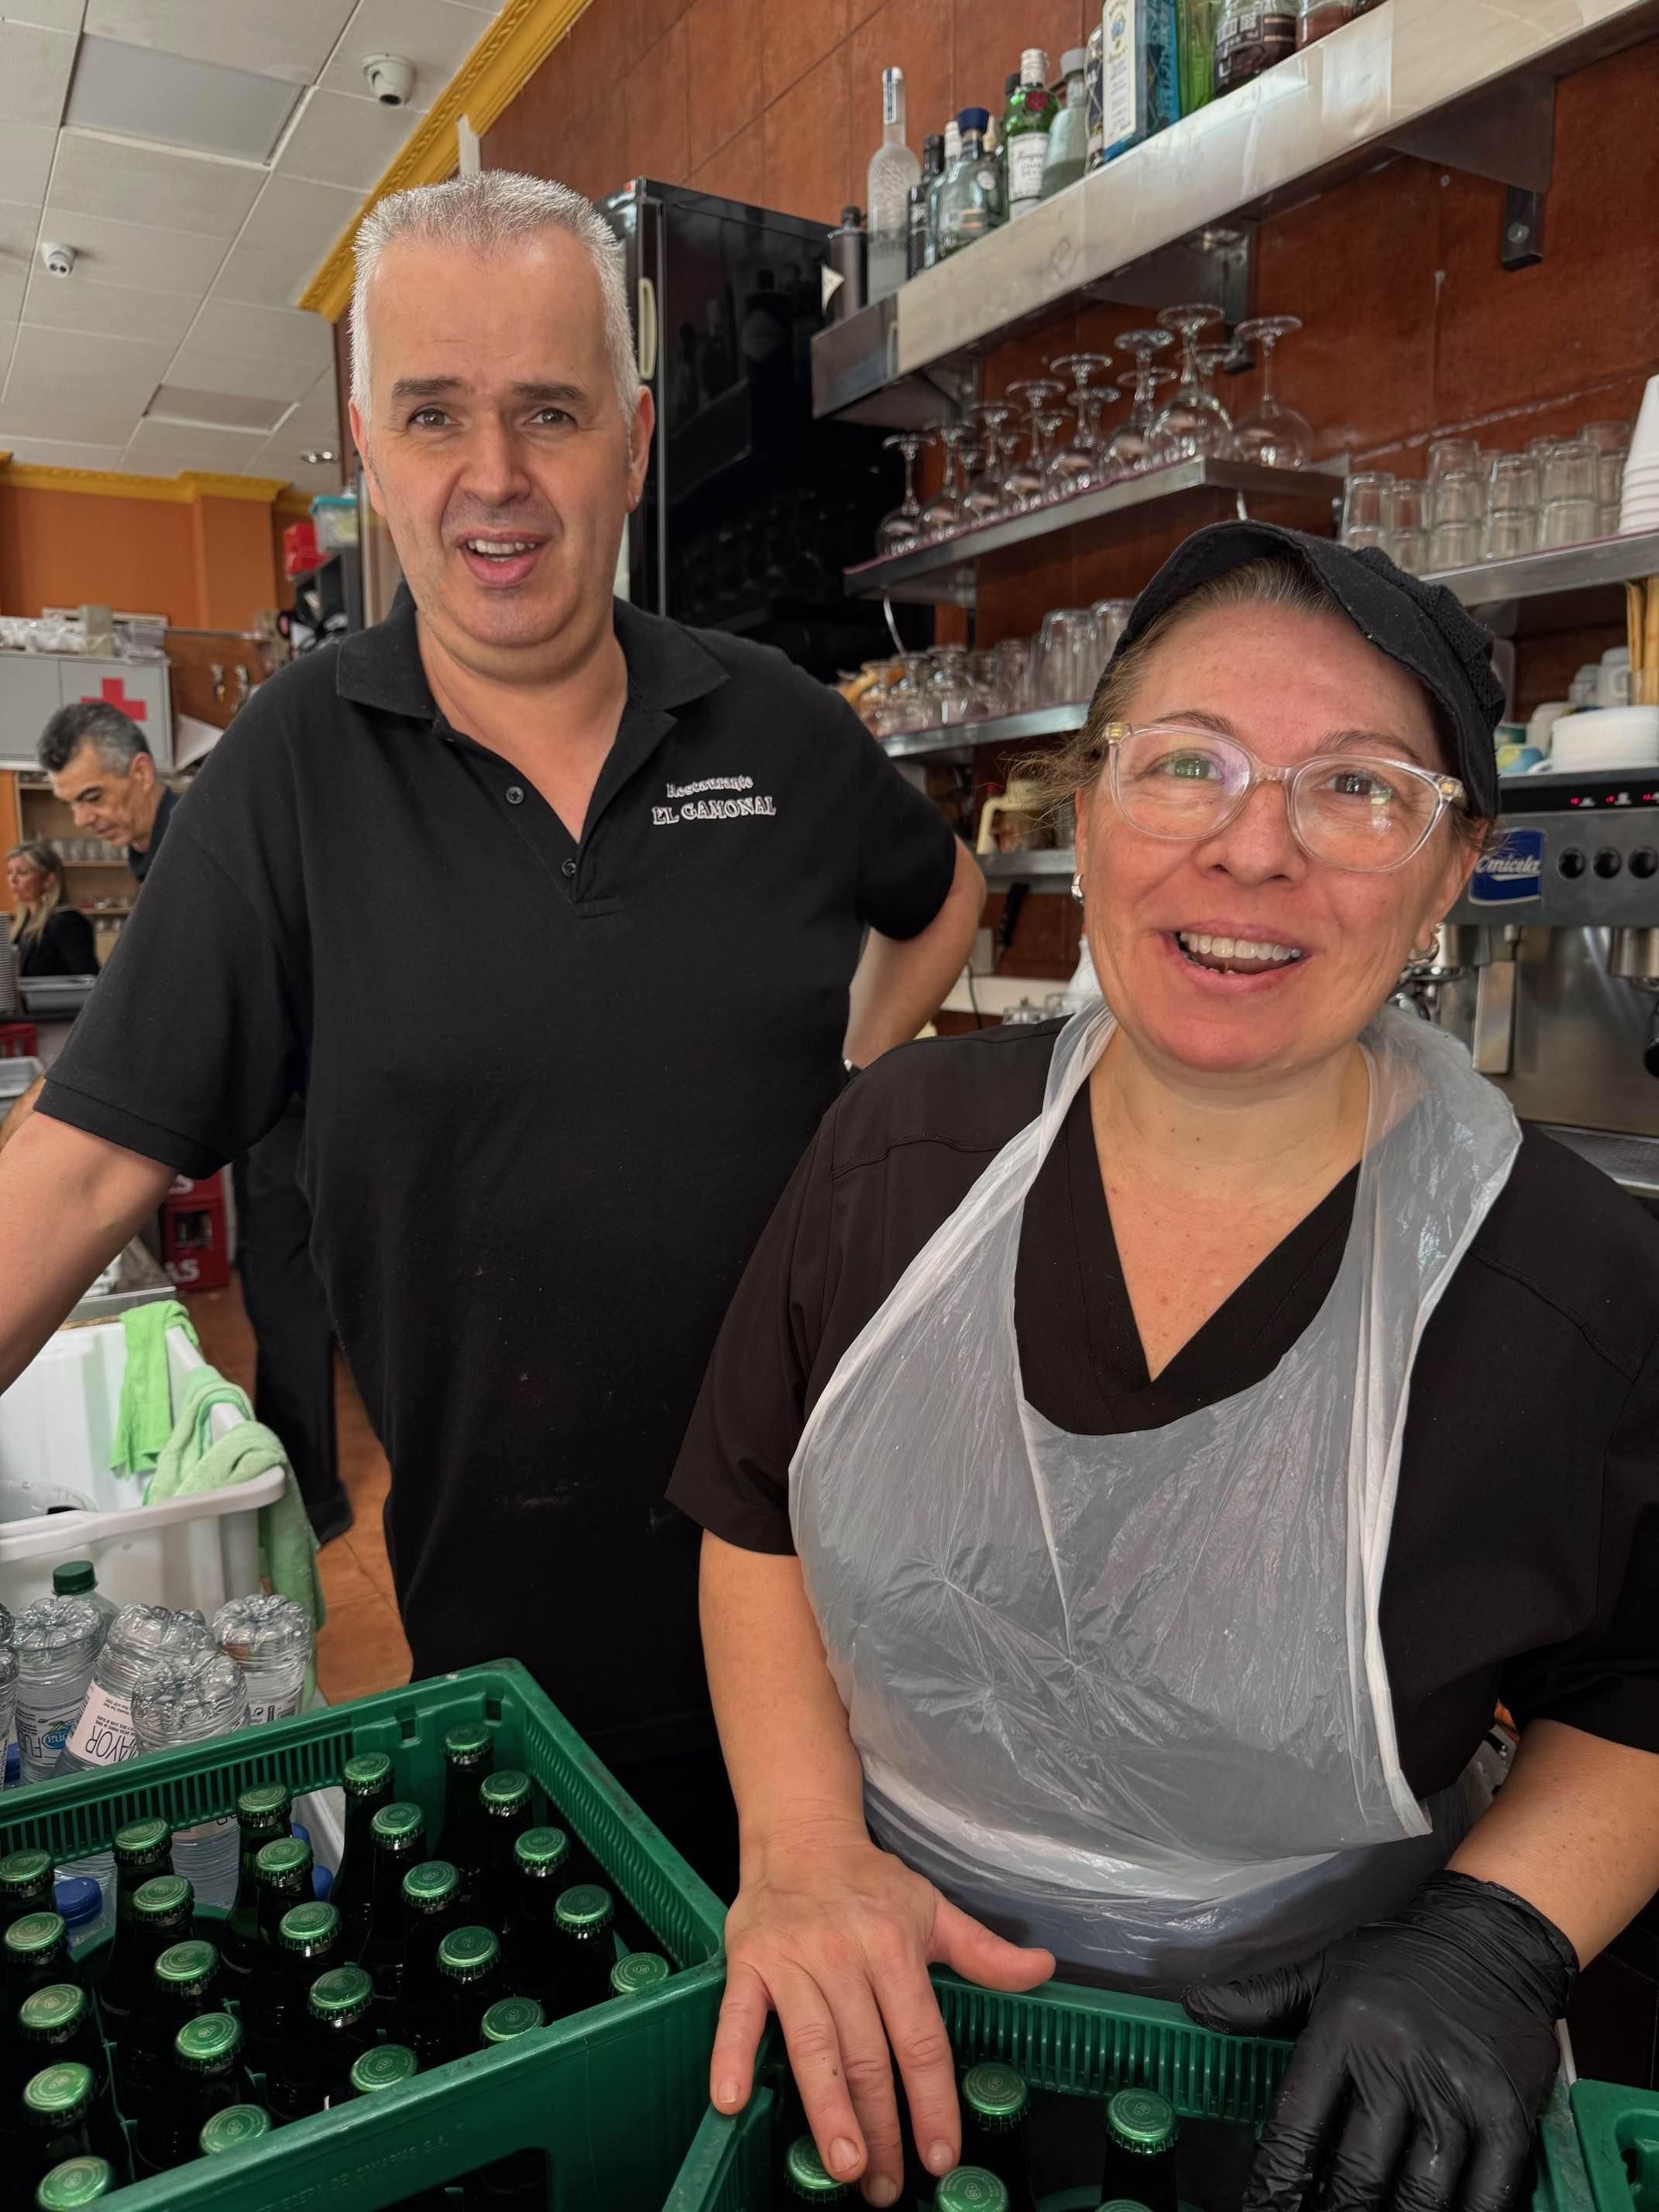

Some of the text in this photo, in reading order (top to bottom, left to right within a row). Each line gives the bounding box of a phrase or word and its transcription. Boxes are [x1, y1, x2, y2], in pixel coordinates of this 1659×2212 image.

[666, 775, 754, 799] Restaurante
[651, 795, 776, 826] EL GAMONAL
